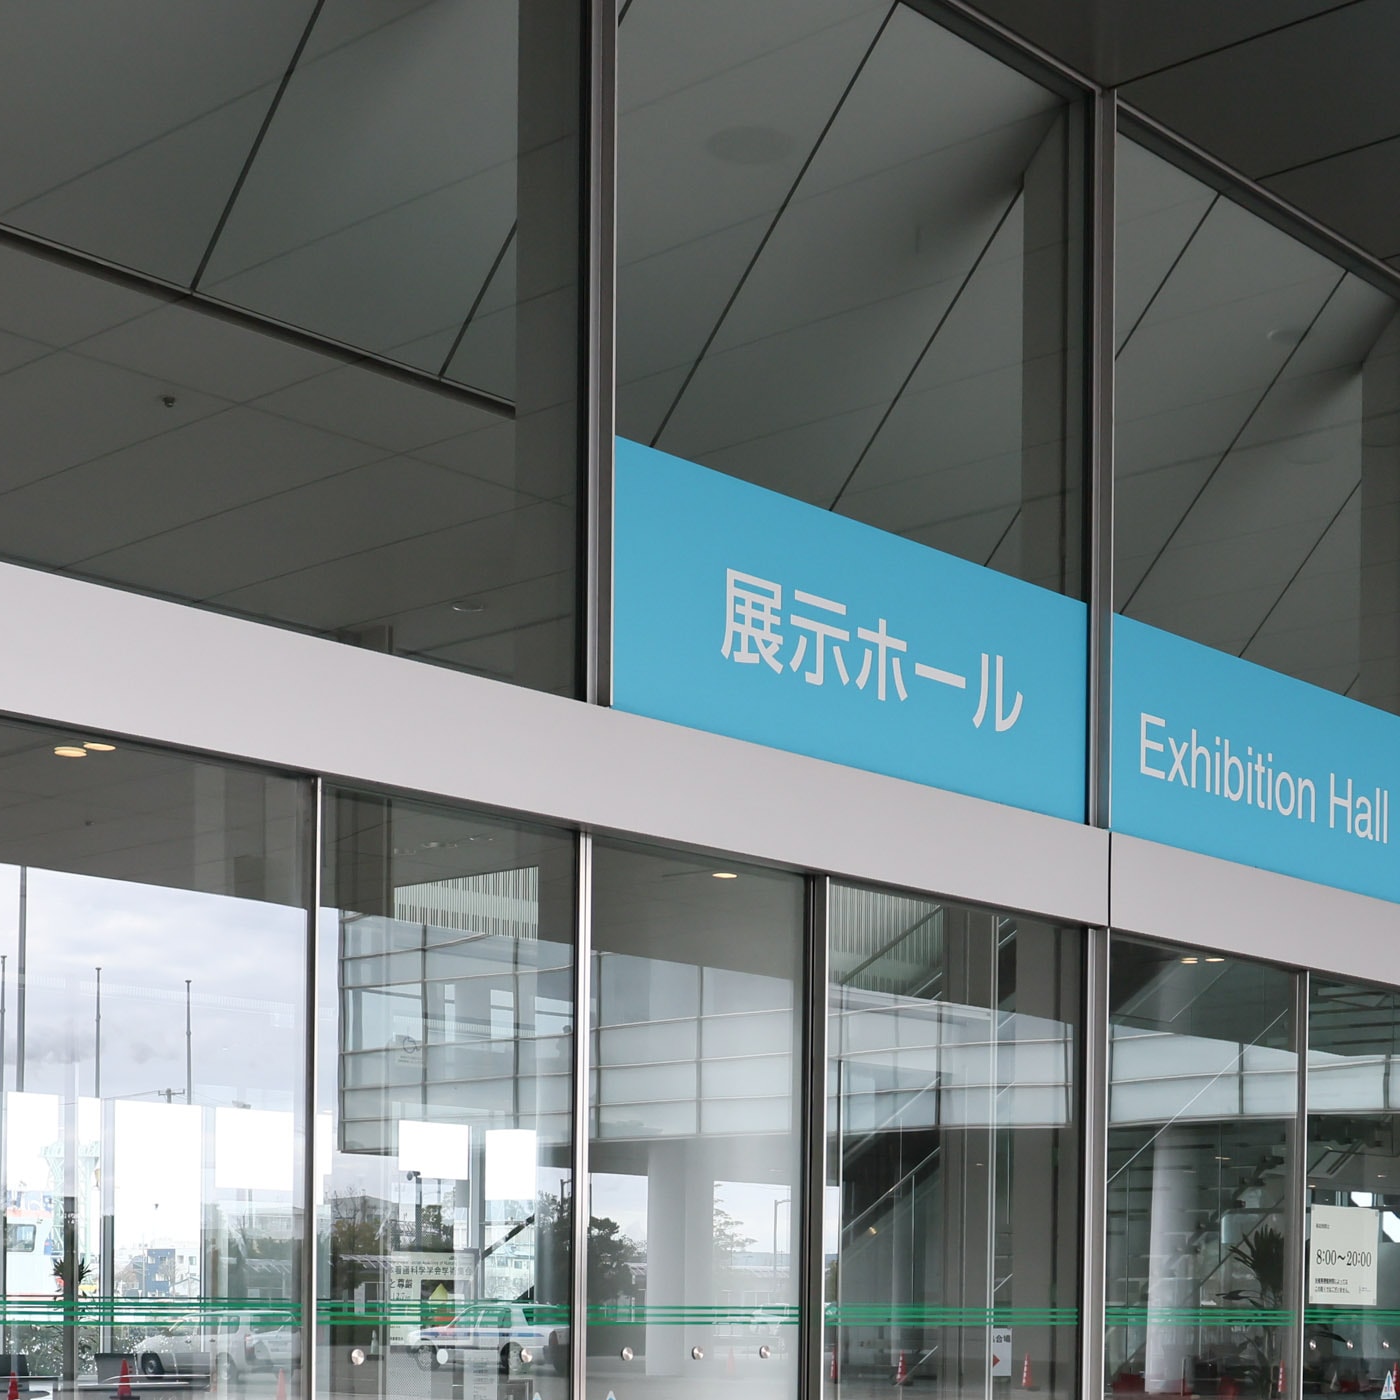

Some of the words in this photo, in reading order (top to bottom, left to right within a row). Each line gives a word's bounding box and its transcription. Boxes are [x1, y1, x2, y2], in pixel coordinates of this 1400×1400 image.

[720, 567, 1024, 733] 展示ホール
[1139, 711, 1316, 824] Exhibition
[1329, 772, 1389, 845] Hall
